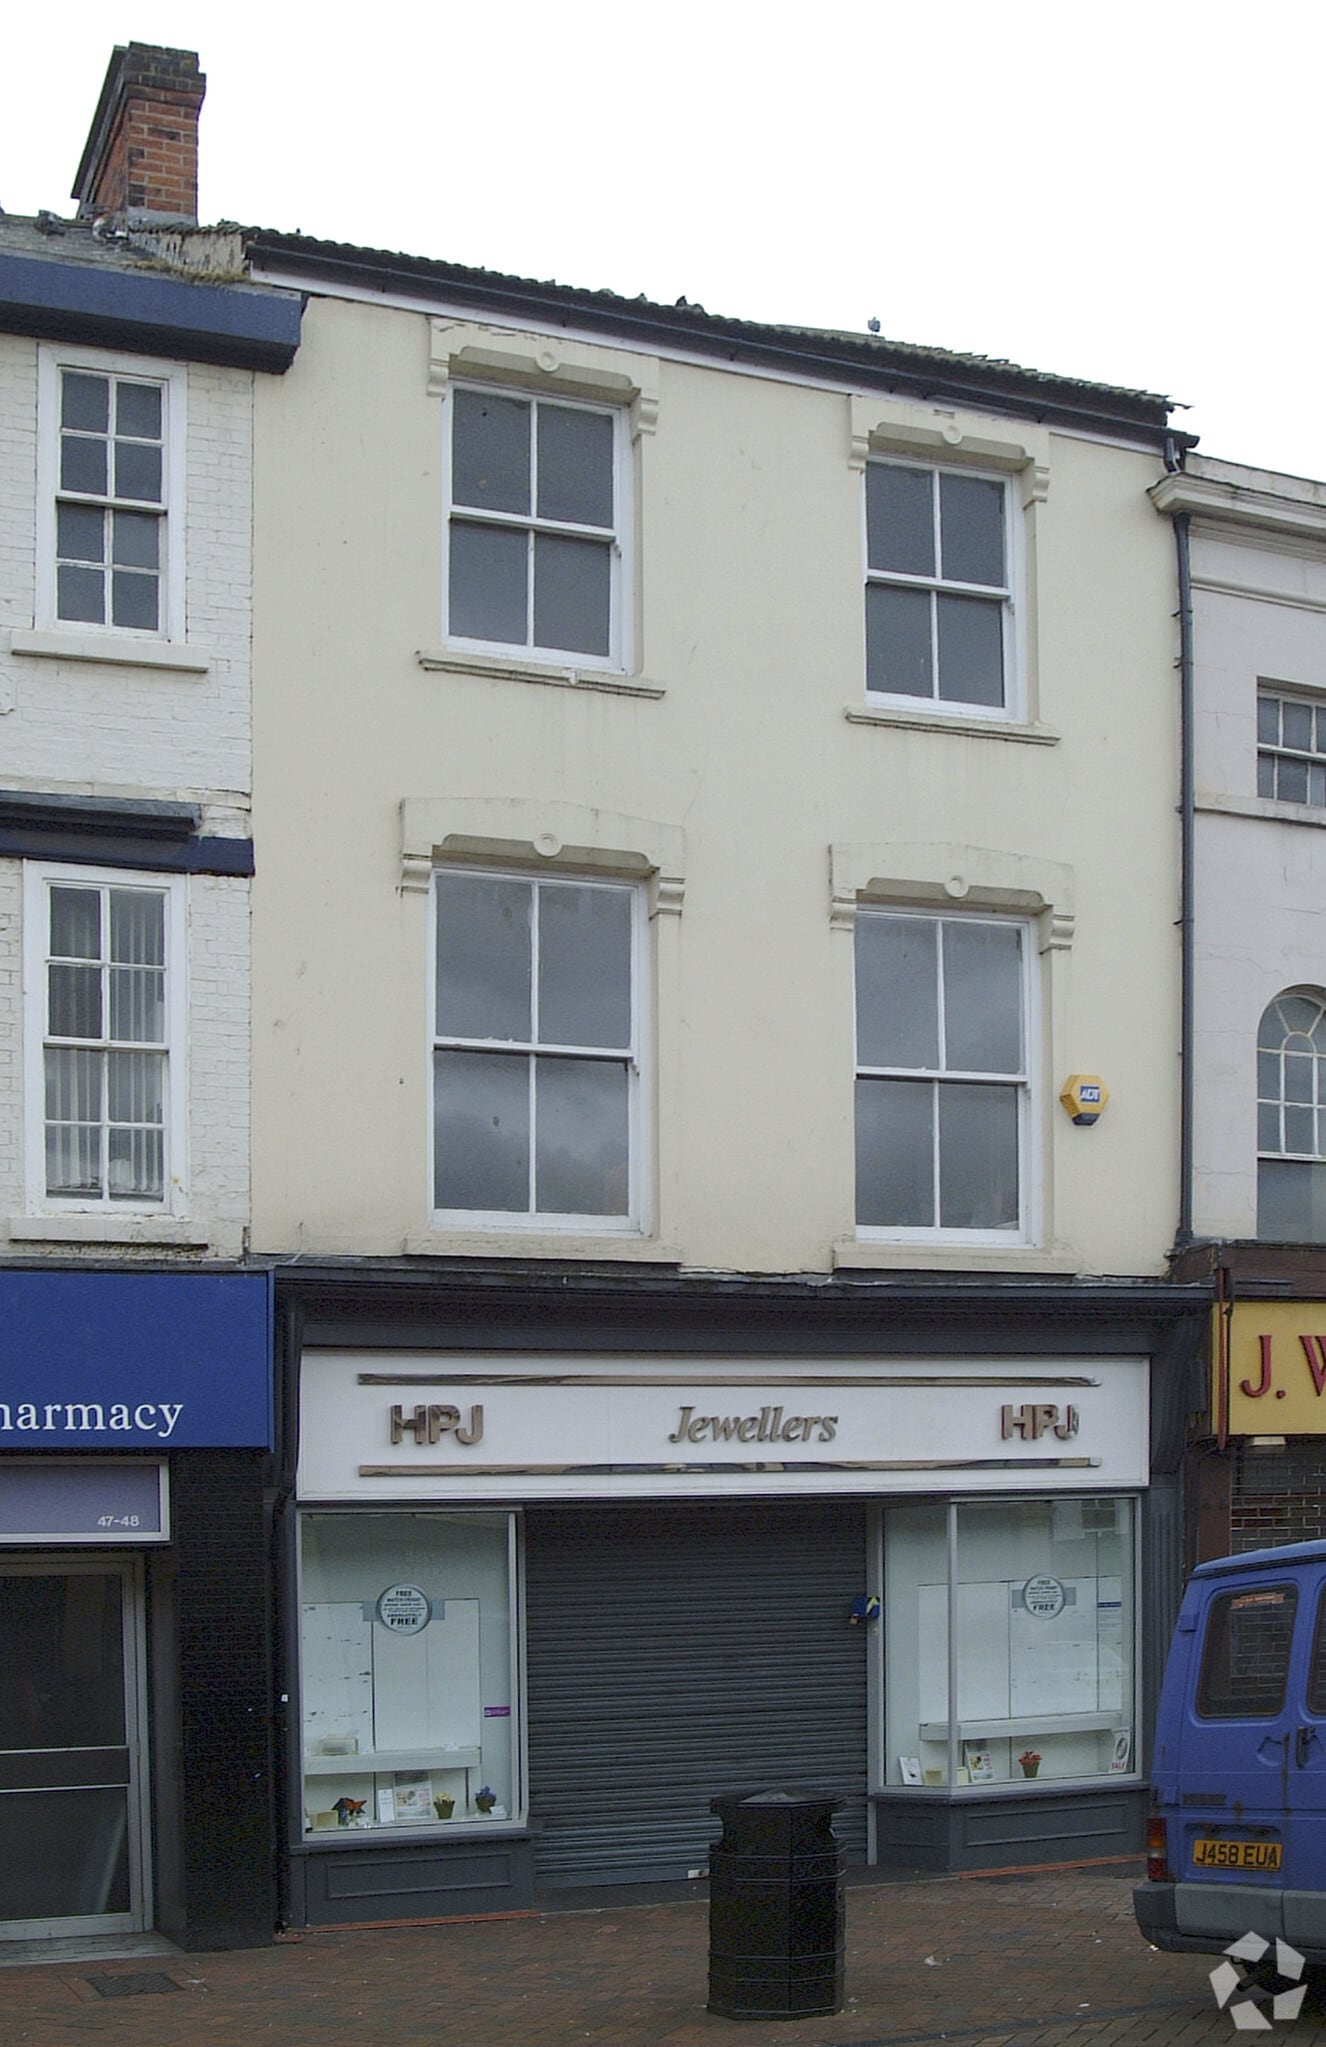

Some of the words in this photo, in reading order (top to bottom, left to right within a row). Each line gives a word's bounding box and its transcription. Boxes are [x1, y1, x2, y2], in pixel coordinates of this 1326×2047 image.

[1239, 1335, 1287, 1399] J.
[390, 1404, 484, 1445] HPJ
[668, 1406, 839, 1444] Jewellers
[1001, 1404, 1079, 1440] HPJ
[97, 1515, 139, 1527] 47-48
[1196, 1843, 1239, 1865] J458
[1243, 1845, 1279, 1867] EUA
